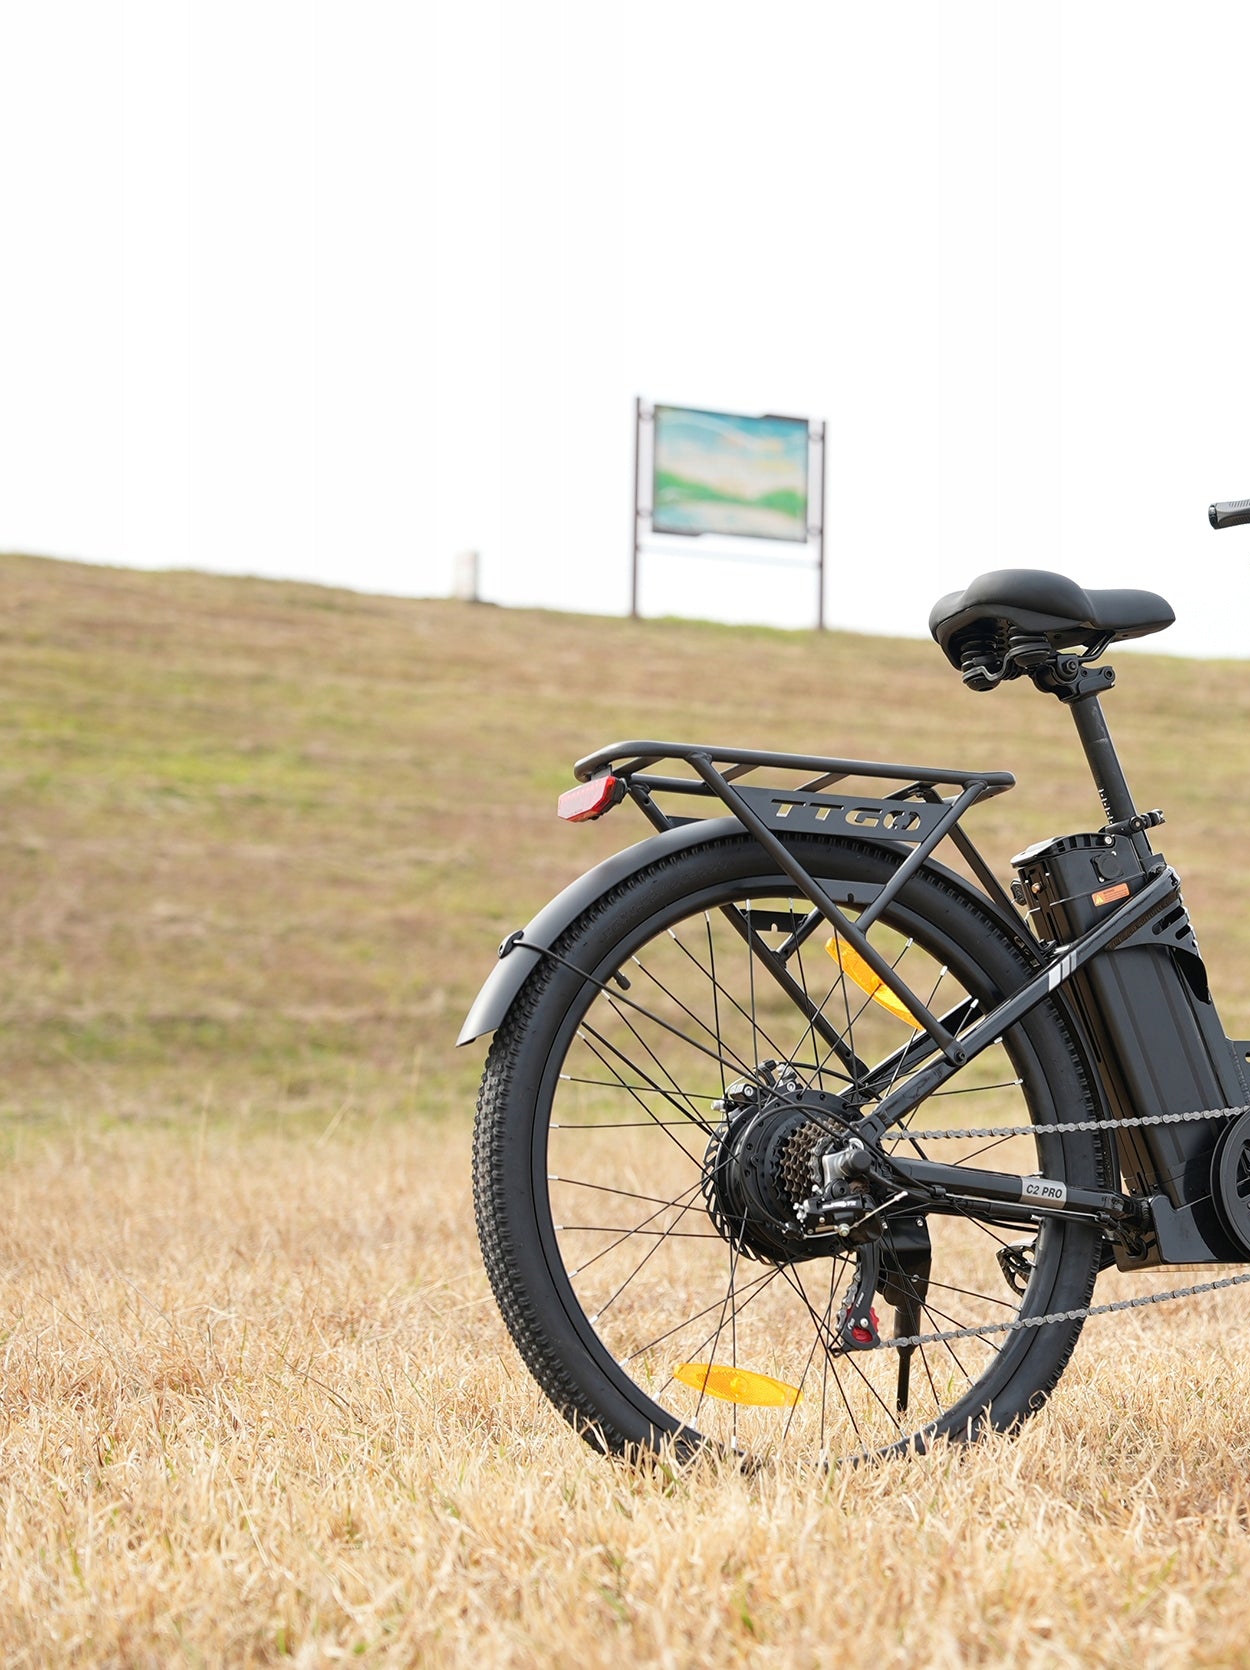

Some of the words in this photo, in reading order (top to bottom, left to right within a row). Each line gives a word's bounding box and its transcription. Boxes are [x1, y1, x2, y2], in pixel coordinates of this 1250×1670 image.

[771, 799, 921, 831] TTGO
[1026, 1184, 1039, 1195] C2
[1042, 1187, 1063, 1199] PRO
